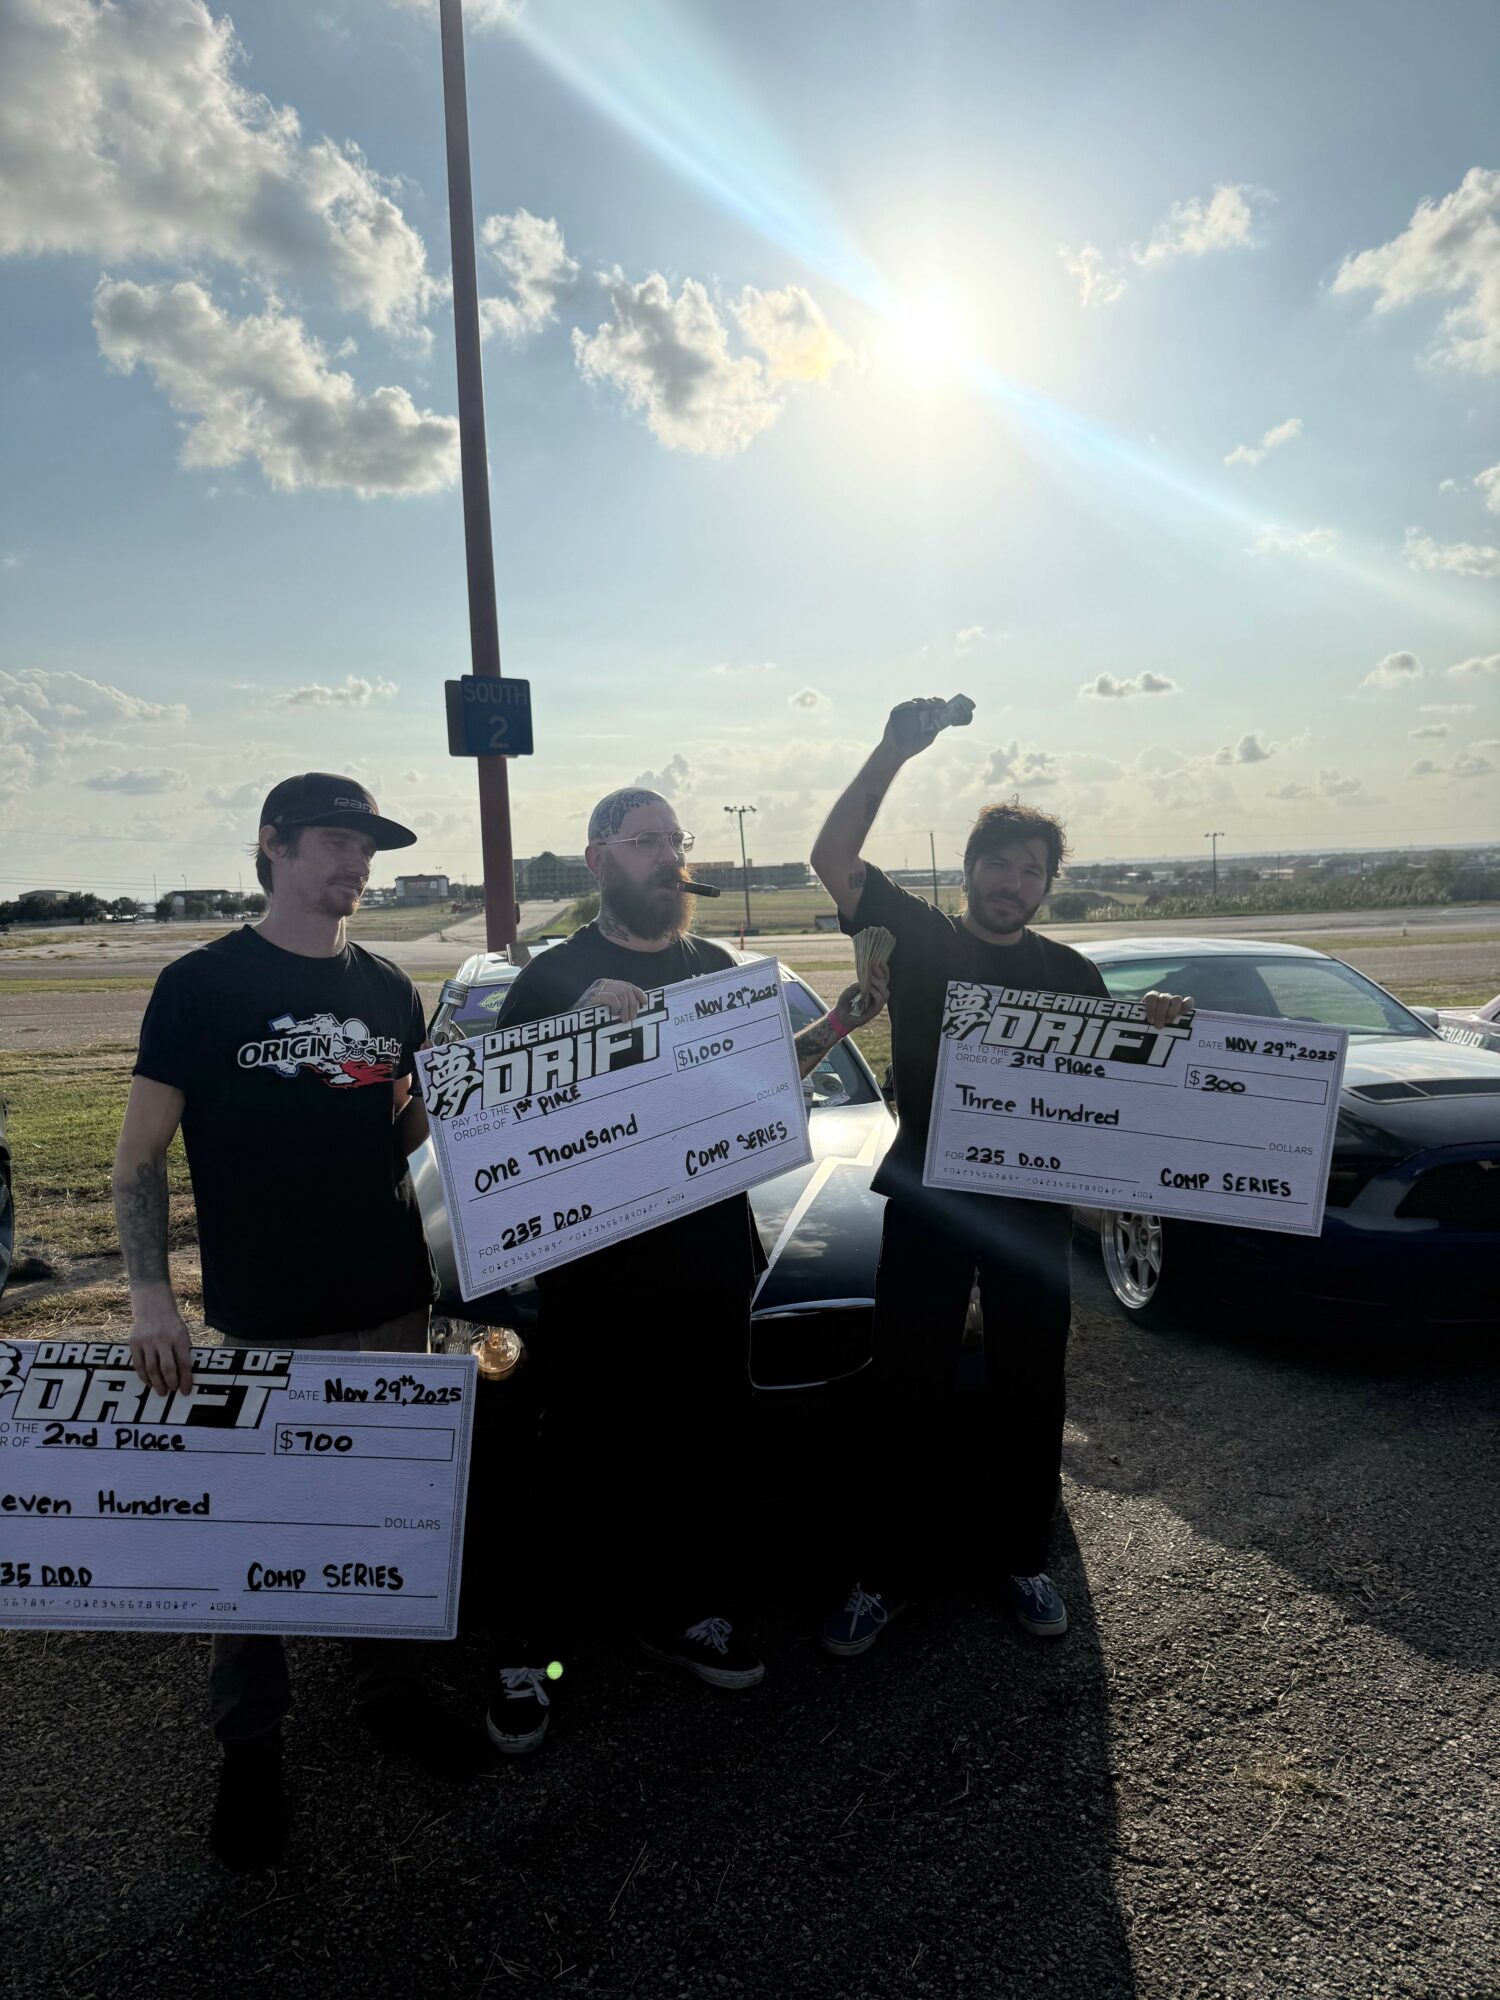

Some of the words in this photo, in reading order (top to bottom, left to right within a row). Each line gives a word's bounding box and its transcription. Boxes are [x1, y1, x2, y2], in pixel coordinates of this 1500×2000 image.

[464, 682, 527, 705] SOUTH
[488, 715, 510, 748] 2
[1000, 987, 1147, 1020] DREAMERS
[674, 1013, 694, 1025] DATE
[981, 1006, 1192, 1067] DRIFT
[1199, 1039, 1223, 1050] DATE
[237, 1034, 333, 1068] ORIGIN
[482, 1008, 668, 1109] DRIFT
[678, 1039, 734, 1067] $1,000
[956, 1054, 988, 1064] ORDER
[991, 1056, 1003, 1065] OF
[957, 1043, 975, 1052] PAY
[977, 1045, 990, 1053] TO
[992, 1046, 1009, 1056] THE
[1297, 1047, 1338, 1061] 2025
[1011, 1051, 1044, 1068] 3rd
[1055, 1056, 1106, 1078] Place
[757, 1082, 789, 1100] DOLLARS
[452, 1118, 471, 1129] PAY
[473, 1111, 488, 1123] TO
[491, 1105, 510, 1118] THE
[513, 1098, 532, 1120] 1st
[955, 1084, 1016, 1113] Three
[1030, 1097, 1119, 1126] Hundred
[455, 1125, 490, 1142] ORDER
[493, 1119, 506, 1130] OF
[737, 1120, 787, 1154] SERIES
[945, 1151, 965, 1161] FOR
[965, 1146, 1005, 1165] 235
[1268, 1142, 1313, 1156] DOLLARS
[474, 1157, 521, 1193] One
[1160, 1167, 1209, 1189] COMP
[1222, 1173, 1292, 1197] SERIES
[502, 1216, 542, 1250] 235
[479, 1244, 500, 1258] FOR
[34, 1342, 236, 1370] DREARS
[243, 1351, 294, 1371] OF
[12, 1367, 291, 1430] DRIFT
[289, 1389, 319, 1400] DATE
[325, 1377, 368, 1403] Nov
[412, 1384, 462, 1404] 2025
[15, 1423, 38, 1433] THE
[42, 1423, 97, 1446] 2nd
[115, 1427, 185, 1450] Place
[12, 1437, 30, 1447] OF
[99, 1491, 210, 1516] Hundred
[384, 1517, 441, 1531] DOLLARS
[248, 1562, 305, 1591] COMP
[323, 1563, 404, 1591] SERIES
